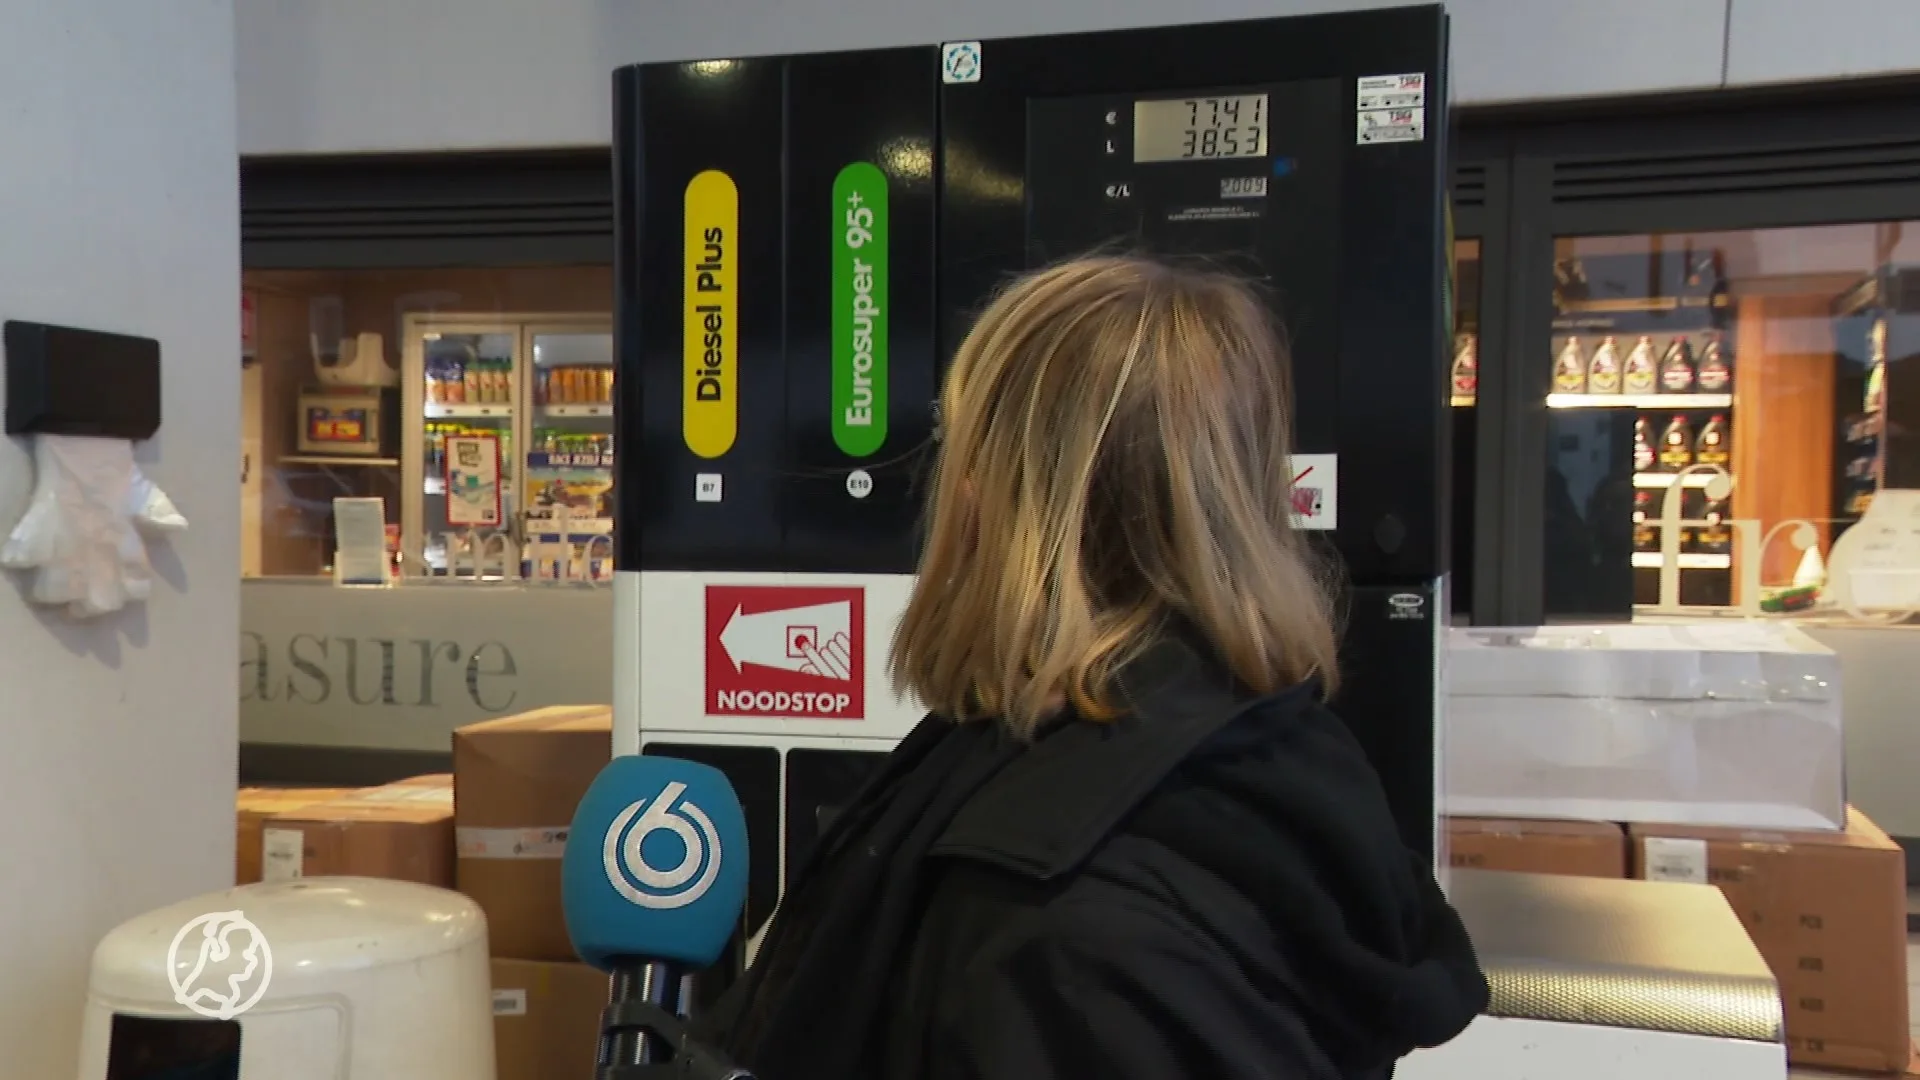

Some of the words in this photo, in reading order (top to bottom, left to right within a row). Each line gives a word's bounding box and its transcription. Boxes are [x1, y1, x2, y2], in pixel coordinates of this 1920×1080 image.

[1184, 99, 1261, 128] 77,41
[1106, 139, 1116, 153] L
[1182, 126, 1260, 159] 38,53
[845, 190, 874, 249] 95+
[695, 226, 723, 292] Plus
[695, 305, 723, 402] Diesel
[845, 257, 880, 426] Eurosuper
[850, 479, 869, 490] E10
[717, 690, 851, 713] NOODSTOP
